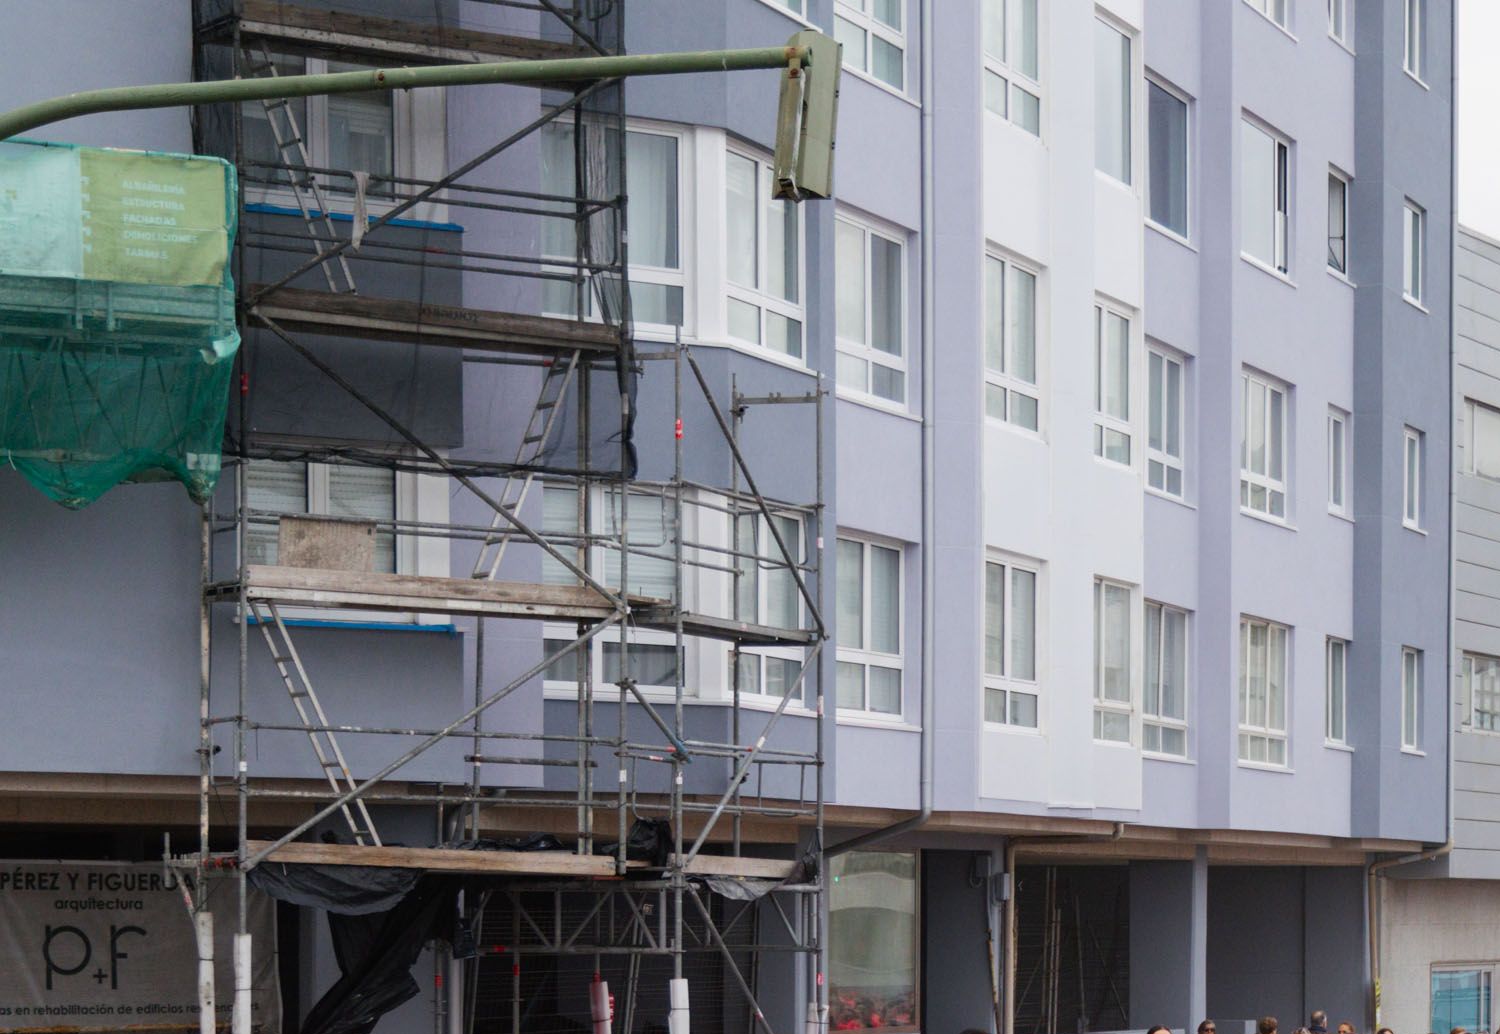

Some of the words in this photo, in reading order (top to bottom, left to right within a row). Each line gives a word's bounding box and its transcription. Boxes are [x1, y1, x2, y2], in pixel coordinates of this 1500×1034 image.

[0, 867, 60, 891] PÉREZ
[67, 873, 80, 890] Y
[54, 898, 144, 912] arquitectura
[16, 1007, 30, 1015] en
[34, 1004, 114, 1016] rehabilitación
[118, 1004, 132, 1014] de
[136, 1004, 183, 1014] edificios
